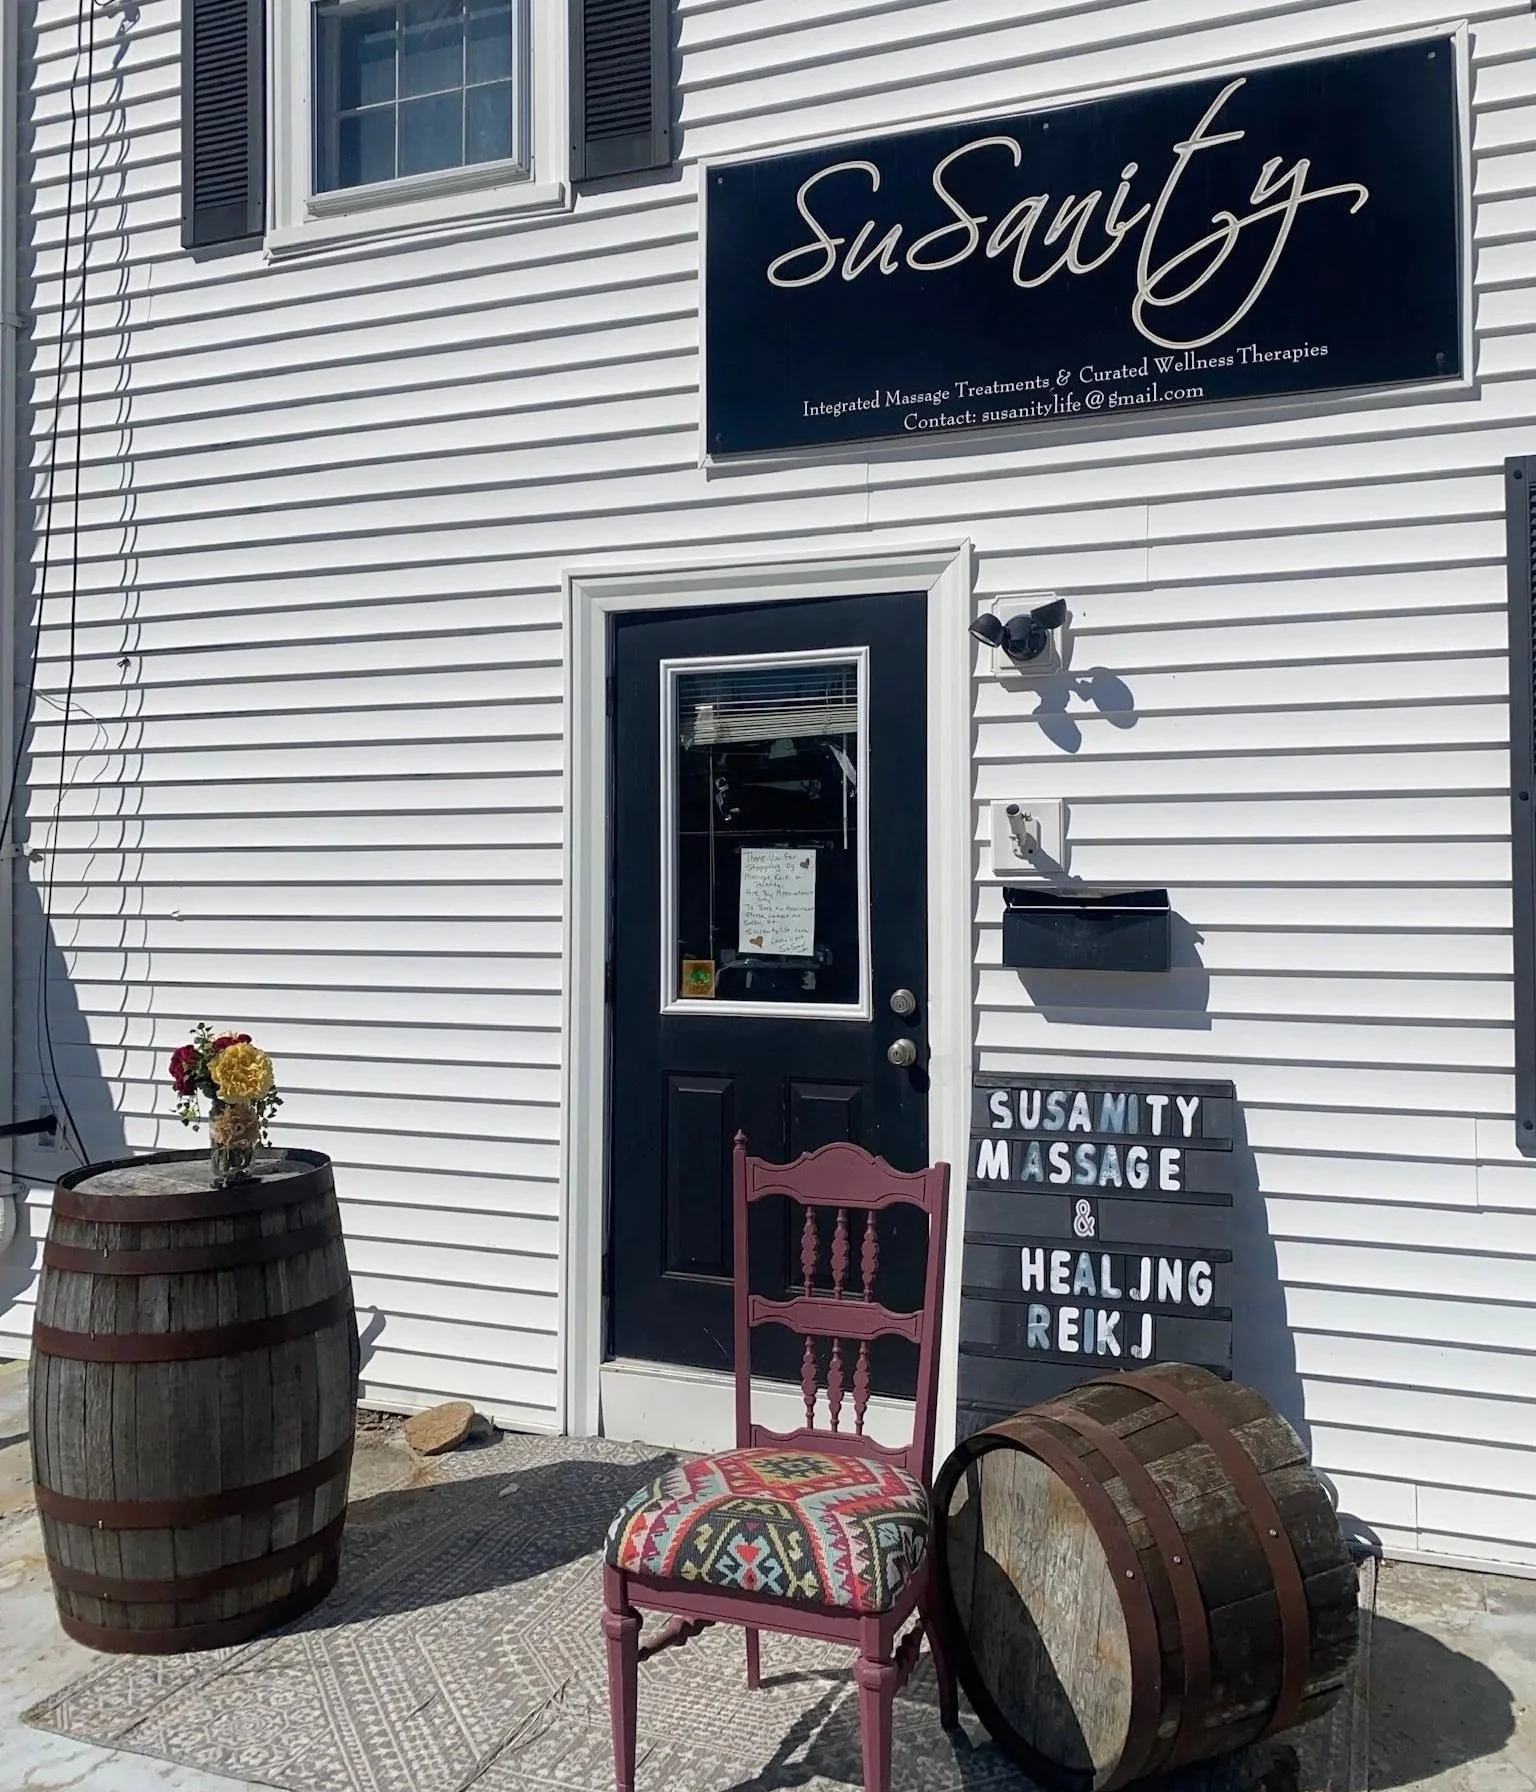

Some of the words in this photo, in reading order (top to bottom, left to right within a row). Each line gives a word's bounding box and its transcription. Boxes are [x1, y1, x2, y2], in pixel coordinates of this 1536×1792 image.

[803, 390, 881, 417] Integrated
[884, 389, 950, 408] Massage
[954, 379, 1050, 399] Treatments
[1056, 368, 1071, 386] &
[1079, 357, 1149, 384] Curated
[1153, 351, 1234, 373] Wellness
[1236, 343, 1329, 366] Therapies
[903, 411, 977, 431] Contact:
[989, 1090, 1200, 1137] SUSANITY
[976, 1138, 1182, 1191] MASSAGE
[1073, 1199, 1095, 1237] &
